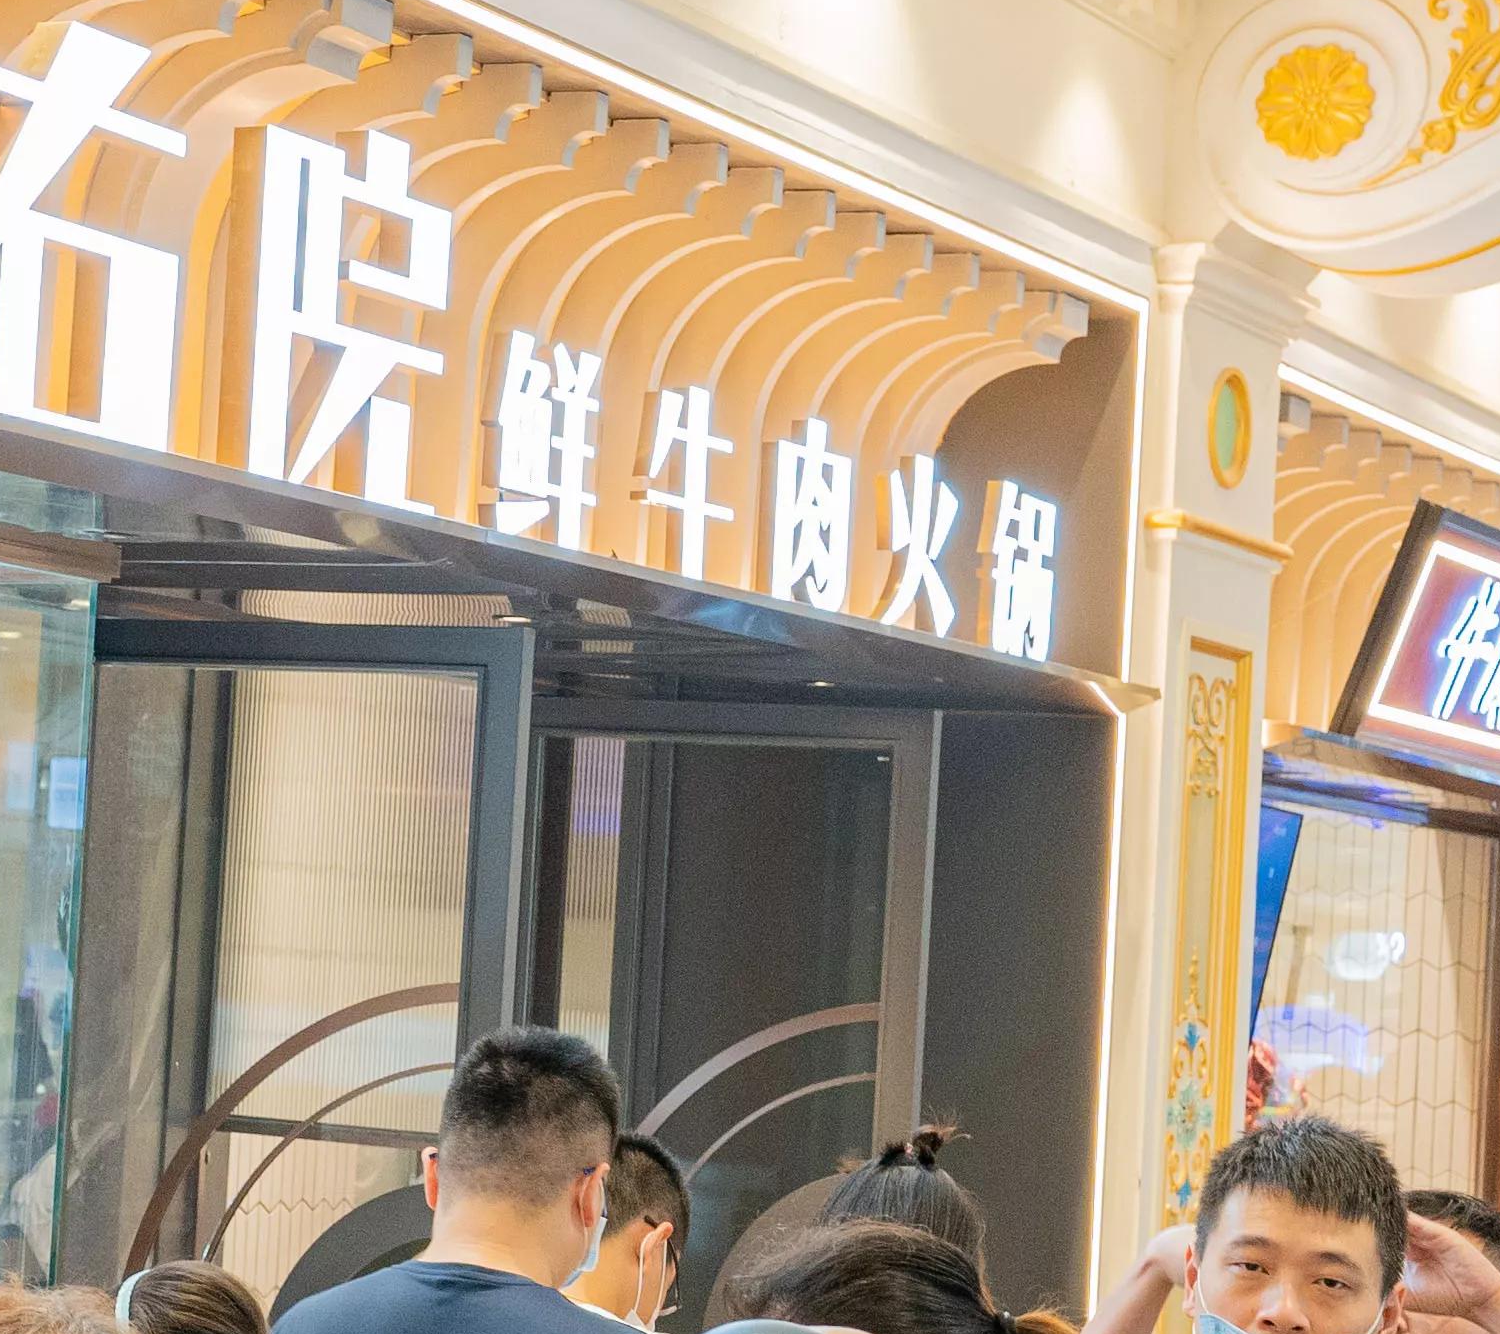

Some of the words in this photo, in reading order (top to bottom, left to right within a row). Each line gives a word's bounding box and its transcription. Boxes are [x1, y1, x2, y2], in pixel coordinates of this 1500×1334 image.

[495, 330, 1058, 663] 鲜牛肉火锅
